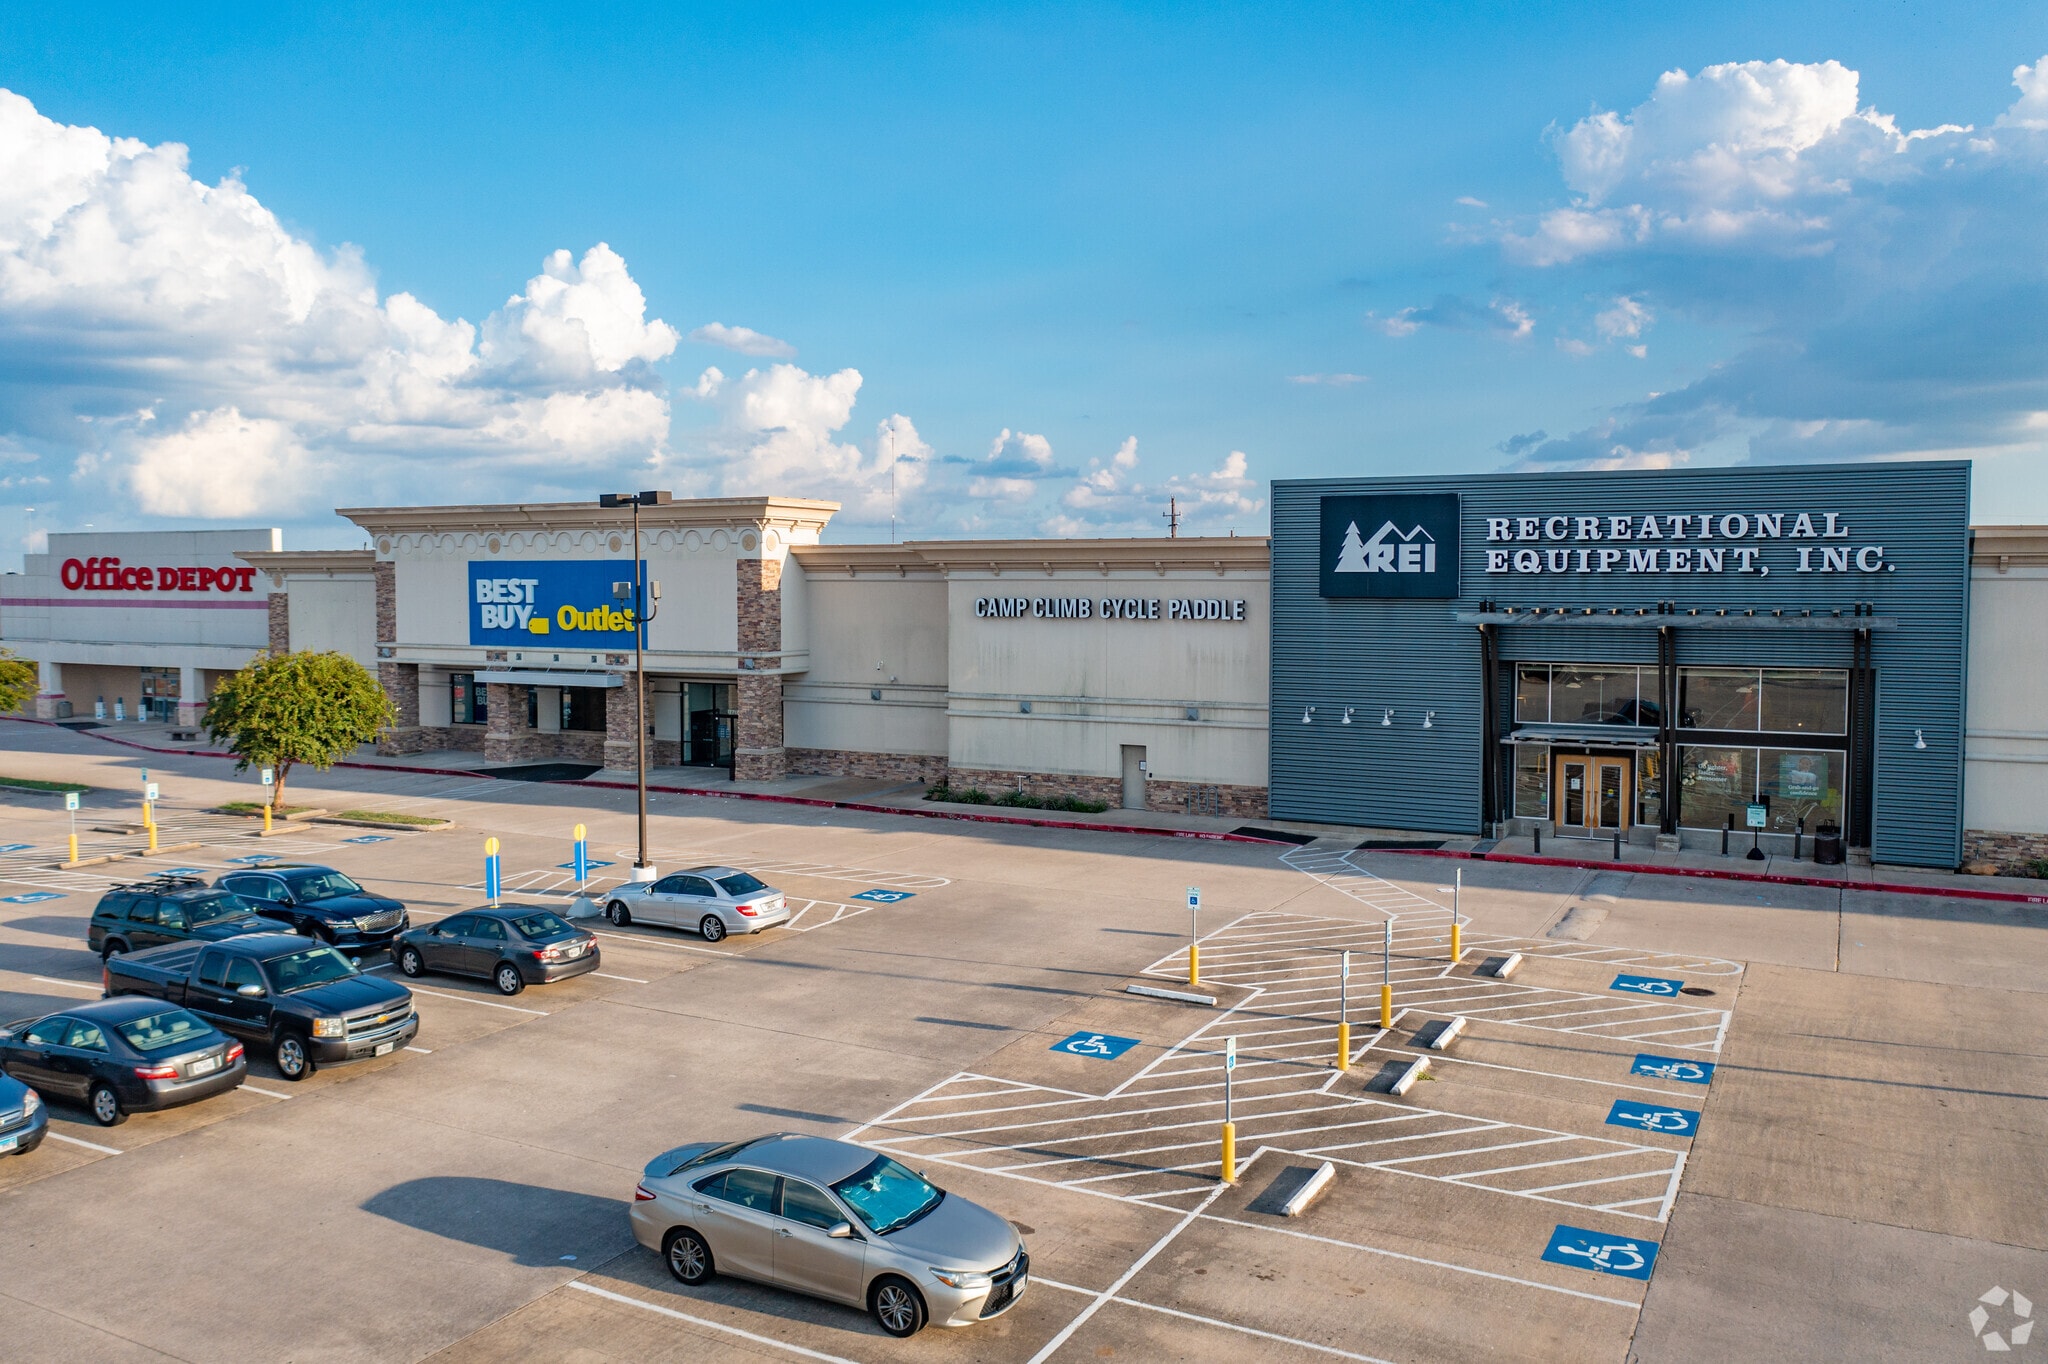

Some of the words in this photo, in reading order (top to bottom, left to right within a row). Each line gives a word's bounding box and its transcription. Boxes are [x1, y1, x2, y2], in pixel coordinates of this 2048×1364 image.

[1486, 513, 1849, 541] RECREATIONAL
[1369, 543, 1436, 573] REI
[1485, 547, 1769, 577] EQUIPMENT,
[1796, 546, 1896, 573] INC.
[61, 557, 153, 591] Office
[157, 566, 256, 592] DEPOT
[476, 578, 538, 603] BEST
[481, 605, 534, 630] BUY
[557, 604, 635, 632] Outlet
[975, 598, 1029, 618] CAMP
[1032, 598, 1092, 619] CLIMB
[1100, 599, 1160, 620] CYCLE
[1168, 599, 1246, 621] PADDLE
[475, 687, 487, 696] BE
